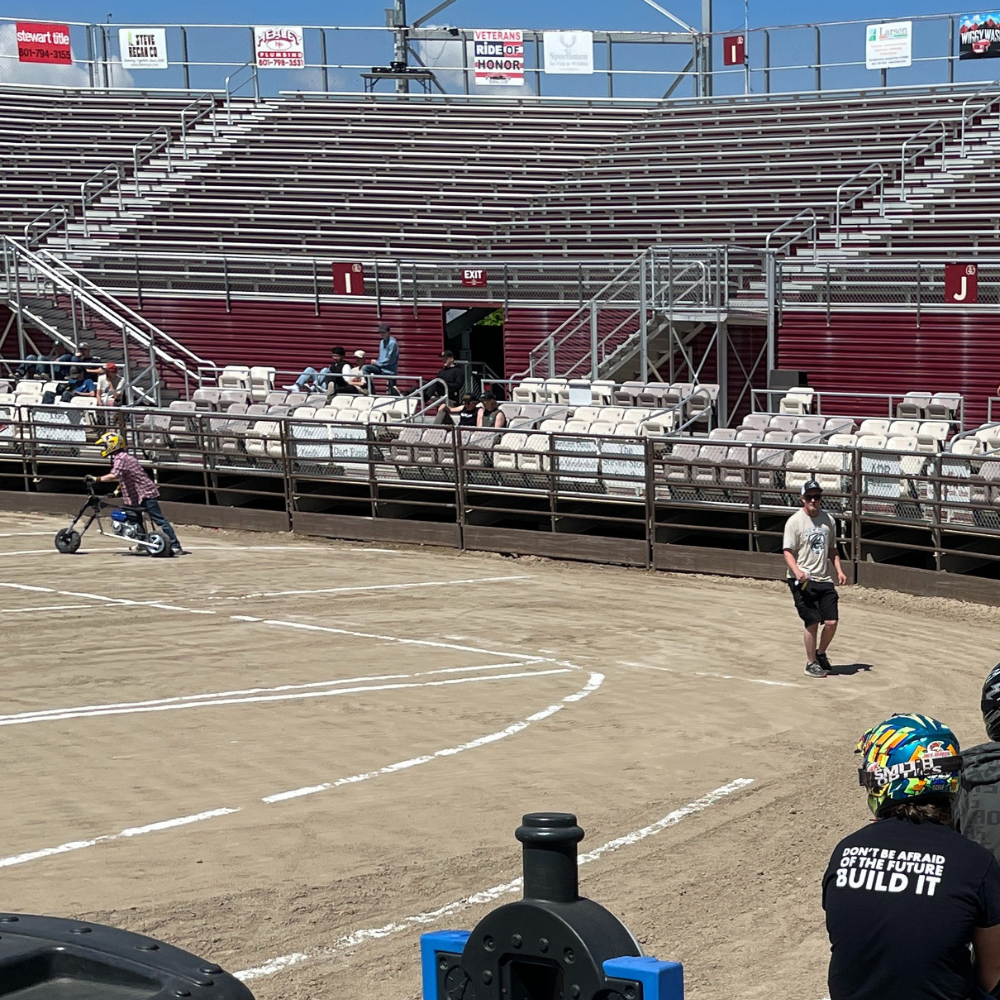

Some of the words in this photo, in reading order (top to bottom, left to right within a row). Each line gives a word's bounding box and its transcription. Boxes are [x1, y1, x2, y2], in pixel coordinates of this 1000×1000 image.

[17, 30, 52, 43] stewart
[52, 32, 70, 45] title
[135, 34, 155, 46] STEVE
[474, 31, 521, 40] VETERANS
[961, 29, 984, 45] WIGGY
[19, 47, 71, 60] 801-794-3155
[505, 45, 520, 55] OF
[477, 59, 521, 70] HONOR
[464, 269, 483, 279] EXIT
[953, 276, 967, 301] J
[842, 846, 880, 858] DON'T
[880, 849, 896, 860] BE
[897, 850, 946, 864] AFRAID
[840, 856, 857, 868] OF
[859, 857, 885, 870] THE
[887, 860, 944, 876] FUTURE
[836, 867, 908, 893] BUILD
[915, 874, 942, 896] IT
